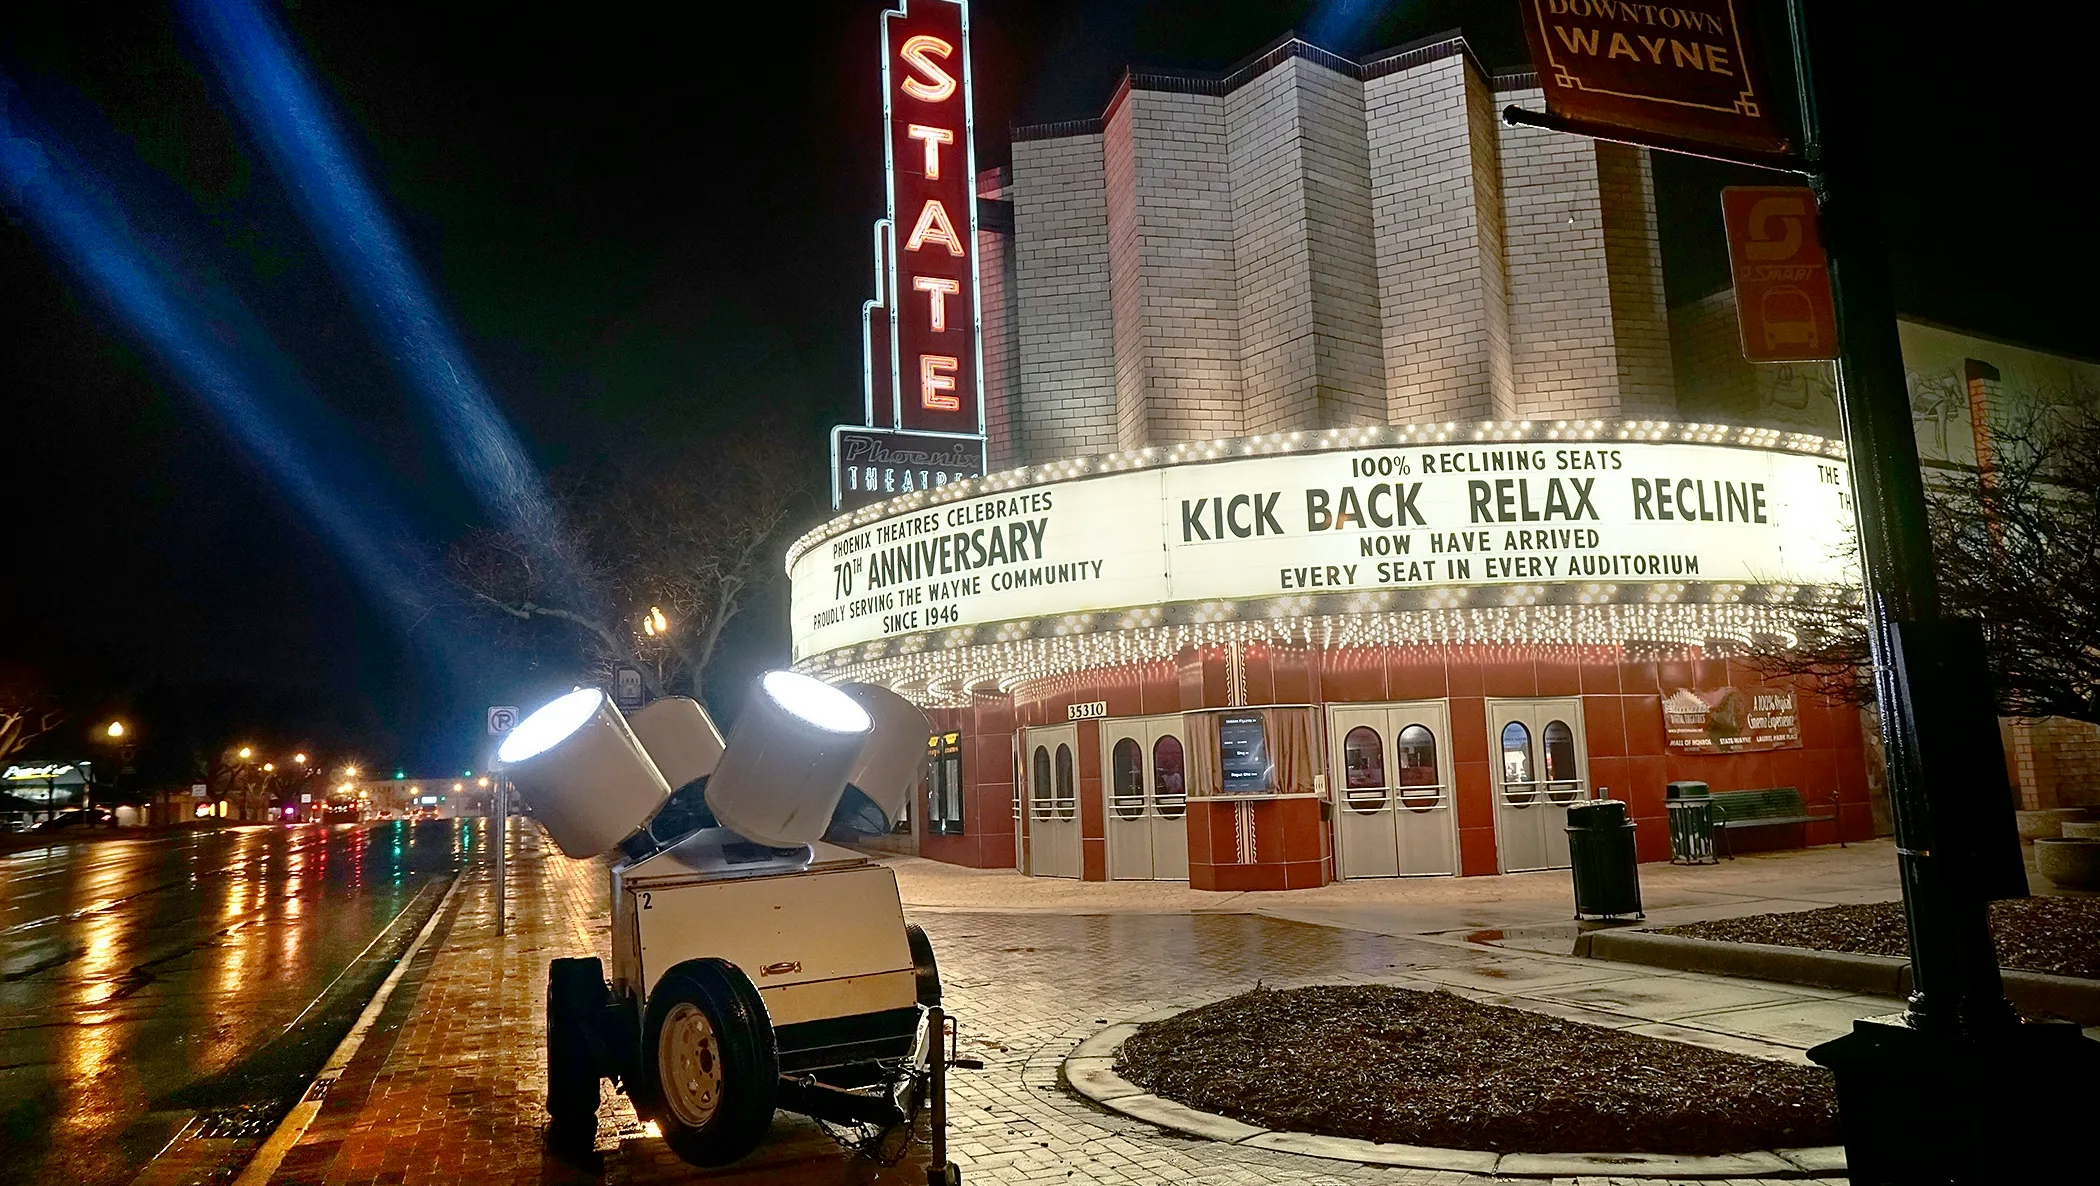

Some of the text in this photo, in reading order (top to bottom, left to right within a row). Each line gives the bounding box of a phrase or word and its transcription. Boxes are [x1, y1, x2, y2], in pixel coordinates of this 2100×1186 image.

[1550, 0, 1724, 36] DOWNTOWN
[1554, 25, 1734, 76] WAYNE
[900, 34, 965, 411] STATE
[843, 435, 980, 468] Phoenix
[1352, 450, 1622, 478] 100% RECLINING SEATS
[1817, 464, 1840, 486] THE
[832, 491, 1053, 559] PHOENIX THEATRES CELEBRATES
[1181, 477, 1768, 542] KICK BACK RELAX RECLINE
[867, 517, 1049, 591] ANNIVERSARY
[1360, 529, 1600, 557] NOW HAVE ARRIVED
[1280, 555, 1699, 589] EVERY SEAT IN EVERY AUDITORIUM
[813, 559, 1103, 631] PROUDLY SERVING THE WAYNE COMMUNITY
[883, 603, 959, 634] SINCE 1946
[1069, 702, 1104, 719] 35310
[642, 892, 653, 910] 2
